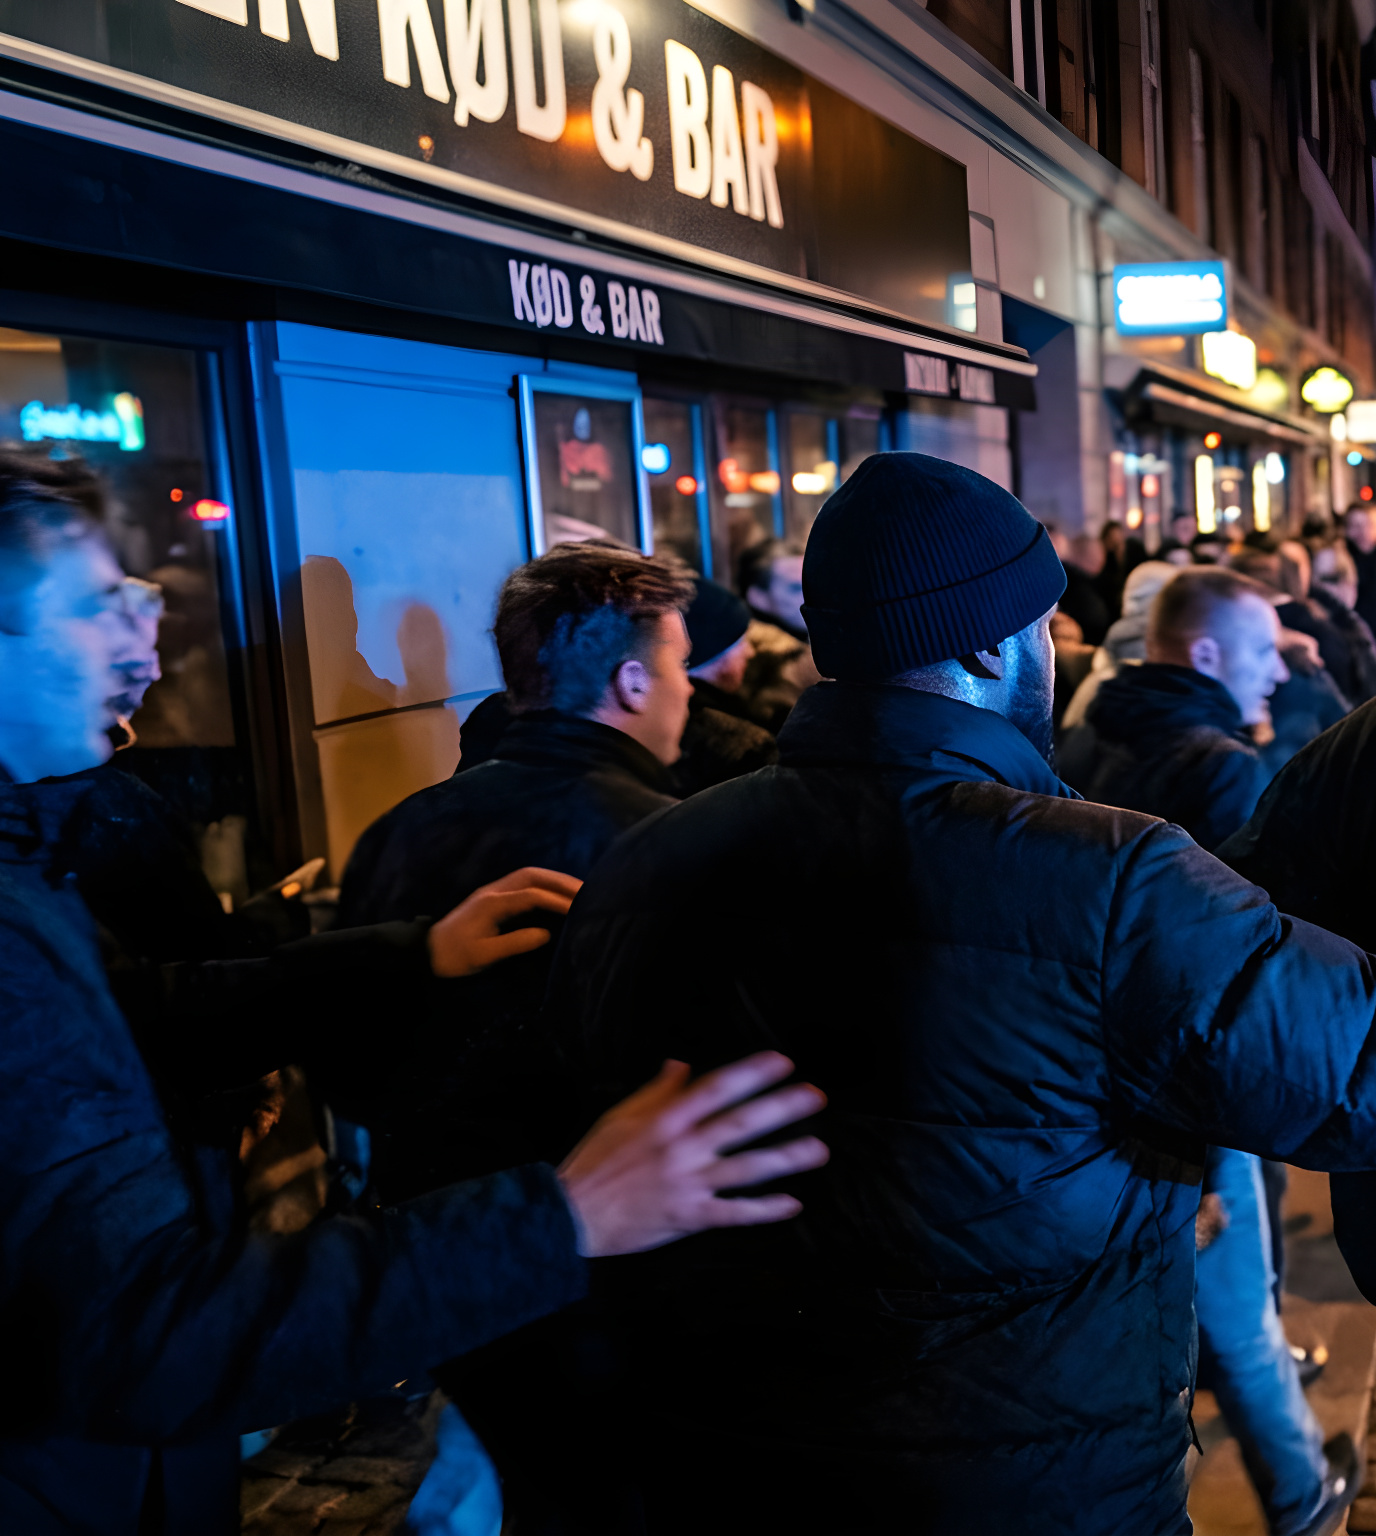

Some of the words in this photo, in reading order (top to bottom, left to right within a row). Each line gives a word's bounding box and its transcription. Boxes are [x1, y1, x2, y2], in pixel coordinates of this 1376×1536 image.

[591, 4, 654, 181] &
[664, 39, 784, 229] BAR
[508, 259, 573, 328] KØD
[579, 274, 606, 335] &
[607, 280, 665, 345] BAR
